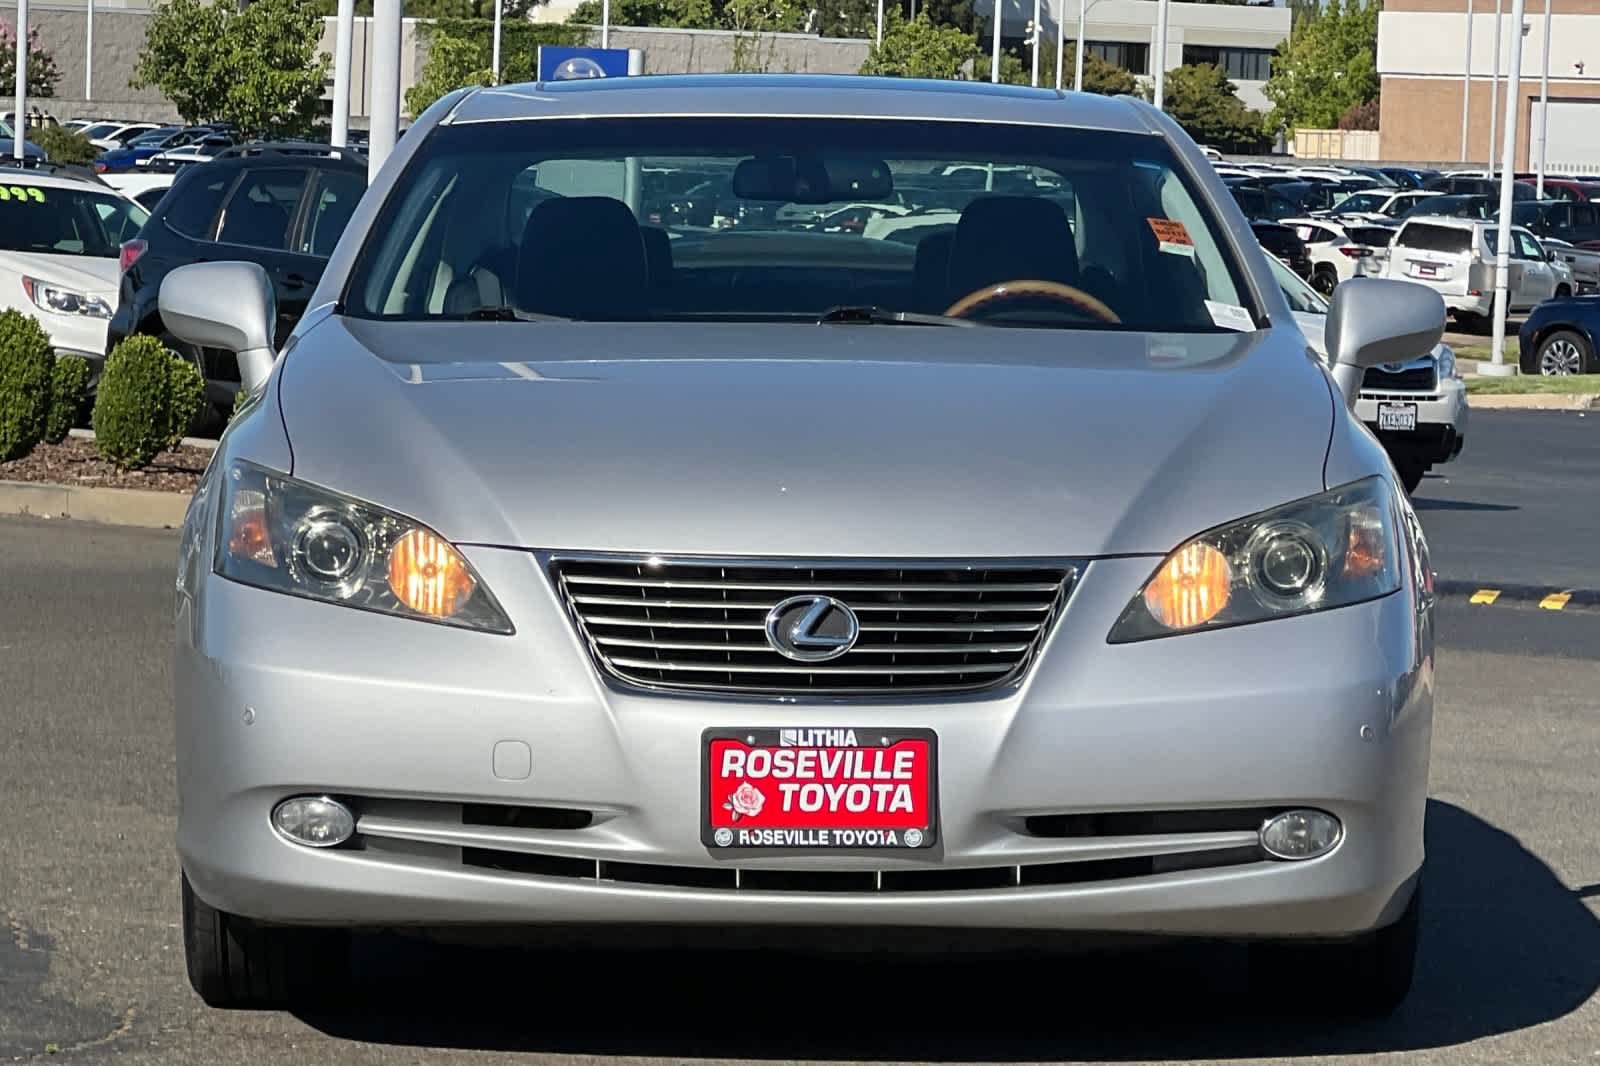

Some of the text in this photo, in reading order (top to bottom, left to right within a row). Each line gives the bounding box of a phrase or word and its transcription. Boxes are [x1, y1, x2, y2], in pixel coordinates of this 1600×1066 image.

[797, 729, 858, 747] LITHIA
[721, 749, 915, 779] ROSEVILLE
[779, 783, 914, 812] TOYOTA
[739, 830, 898, 845] ROSEVILLE TOYOTA
